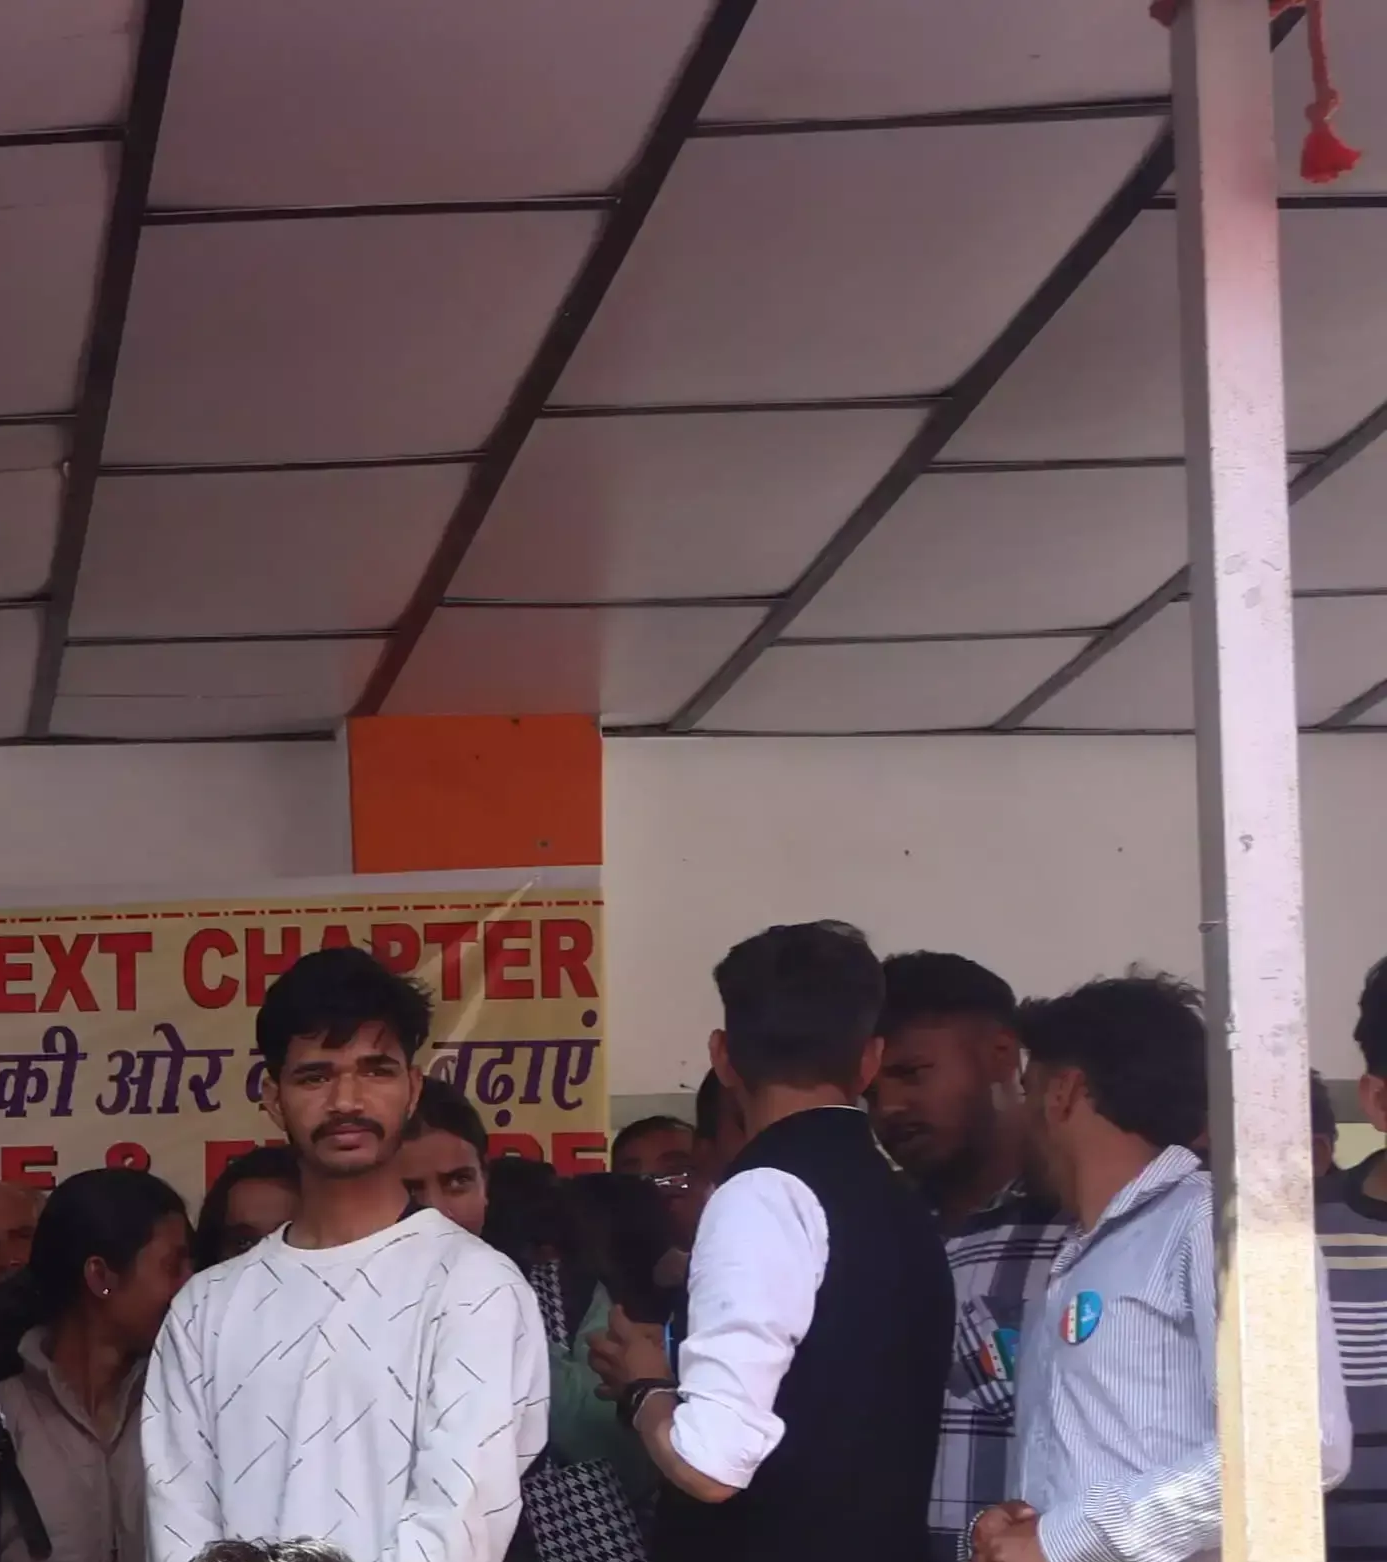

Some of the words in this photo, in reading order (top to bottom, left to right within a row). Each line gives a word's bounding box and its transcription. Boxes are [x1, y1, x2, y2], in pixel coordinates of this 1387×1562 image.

[183, 917, 599, 1010] CHPTER
[95, 1022, 235, 1116] ओर
[430, 1009, 601, 1128] बढ़ाएं
